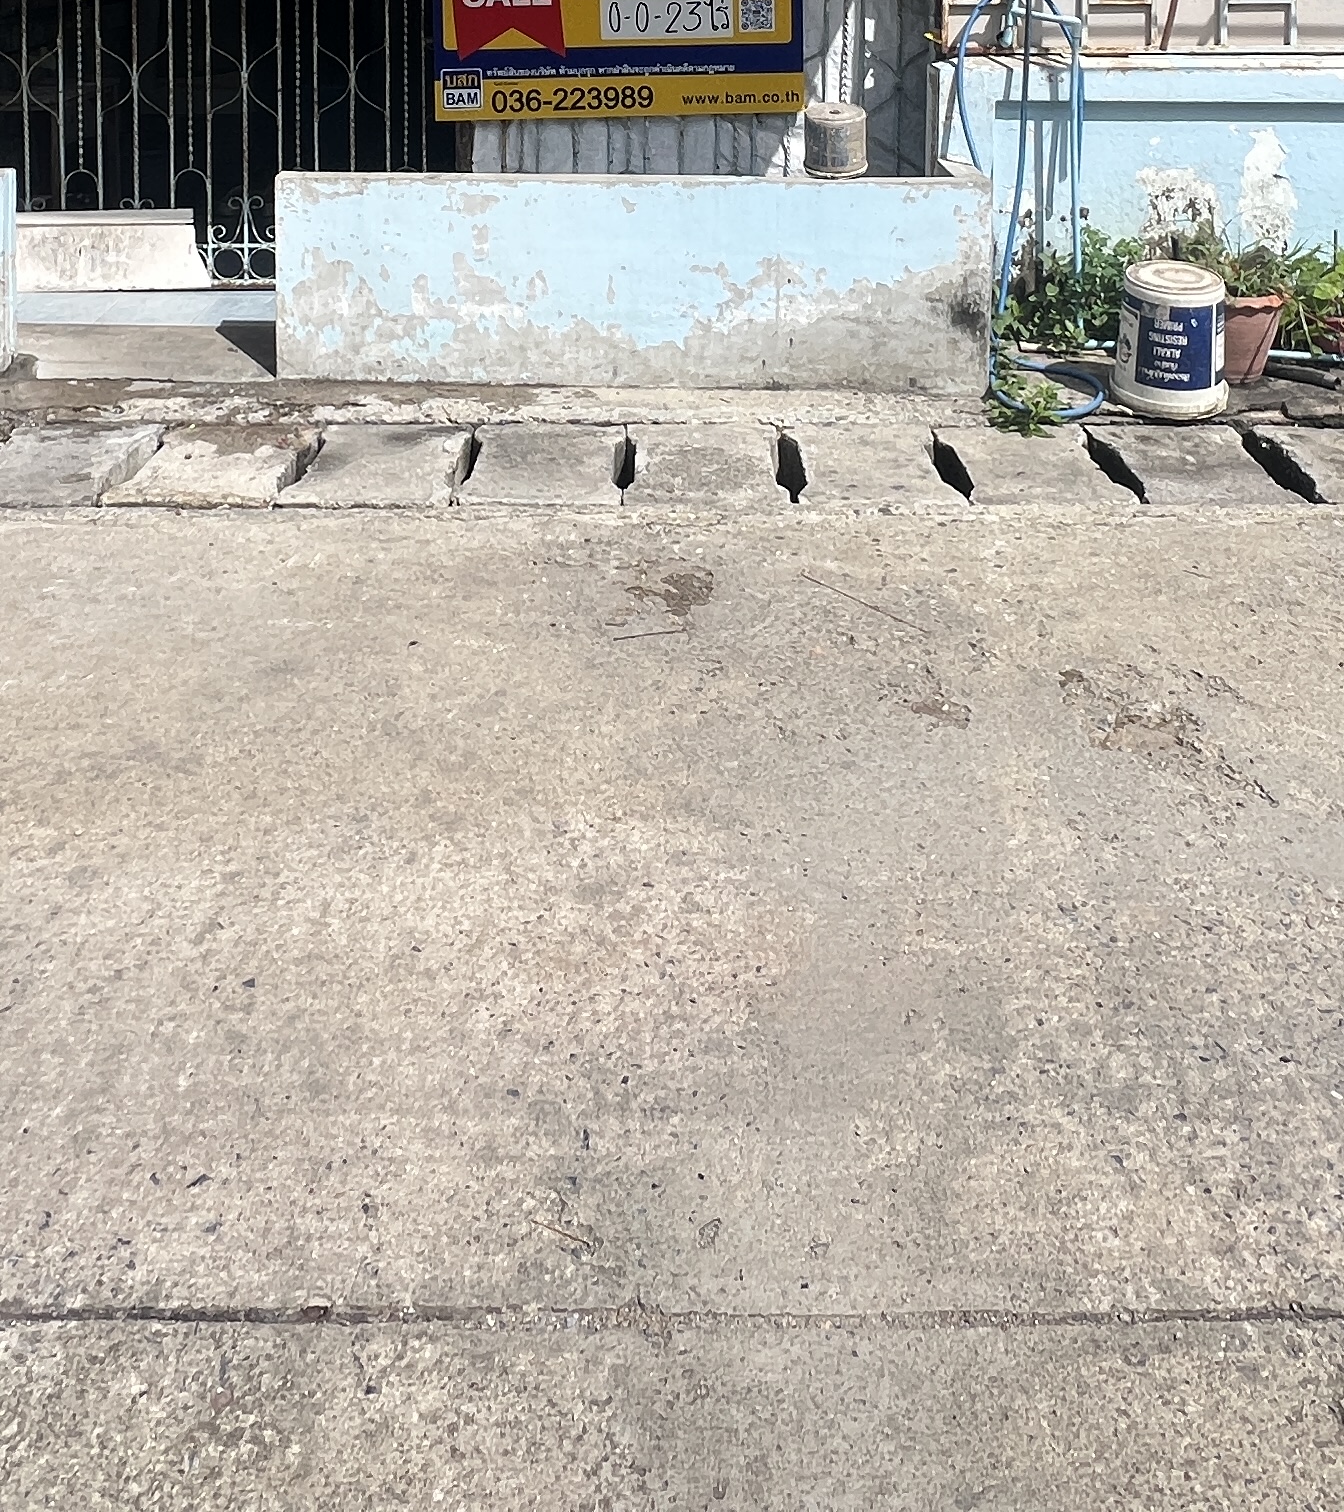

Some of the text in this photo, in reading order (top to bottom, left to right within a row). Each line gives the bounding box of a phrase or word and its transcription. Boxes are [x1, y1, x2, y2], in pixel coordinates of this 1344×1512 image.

[444, 73, 479, 88] บสก
[445, 91, 479, 106] BAM
[491, 85, 654, 113] 036-223989
[681, 90, 800, 106] www.bam.co.th
[1154, 319, 1184, 332] PRIMER
[1148, 331, 1188, 346] RESISTING
